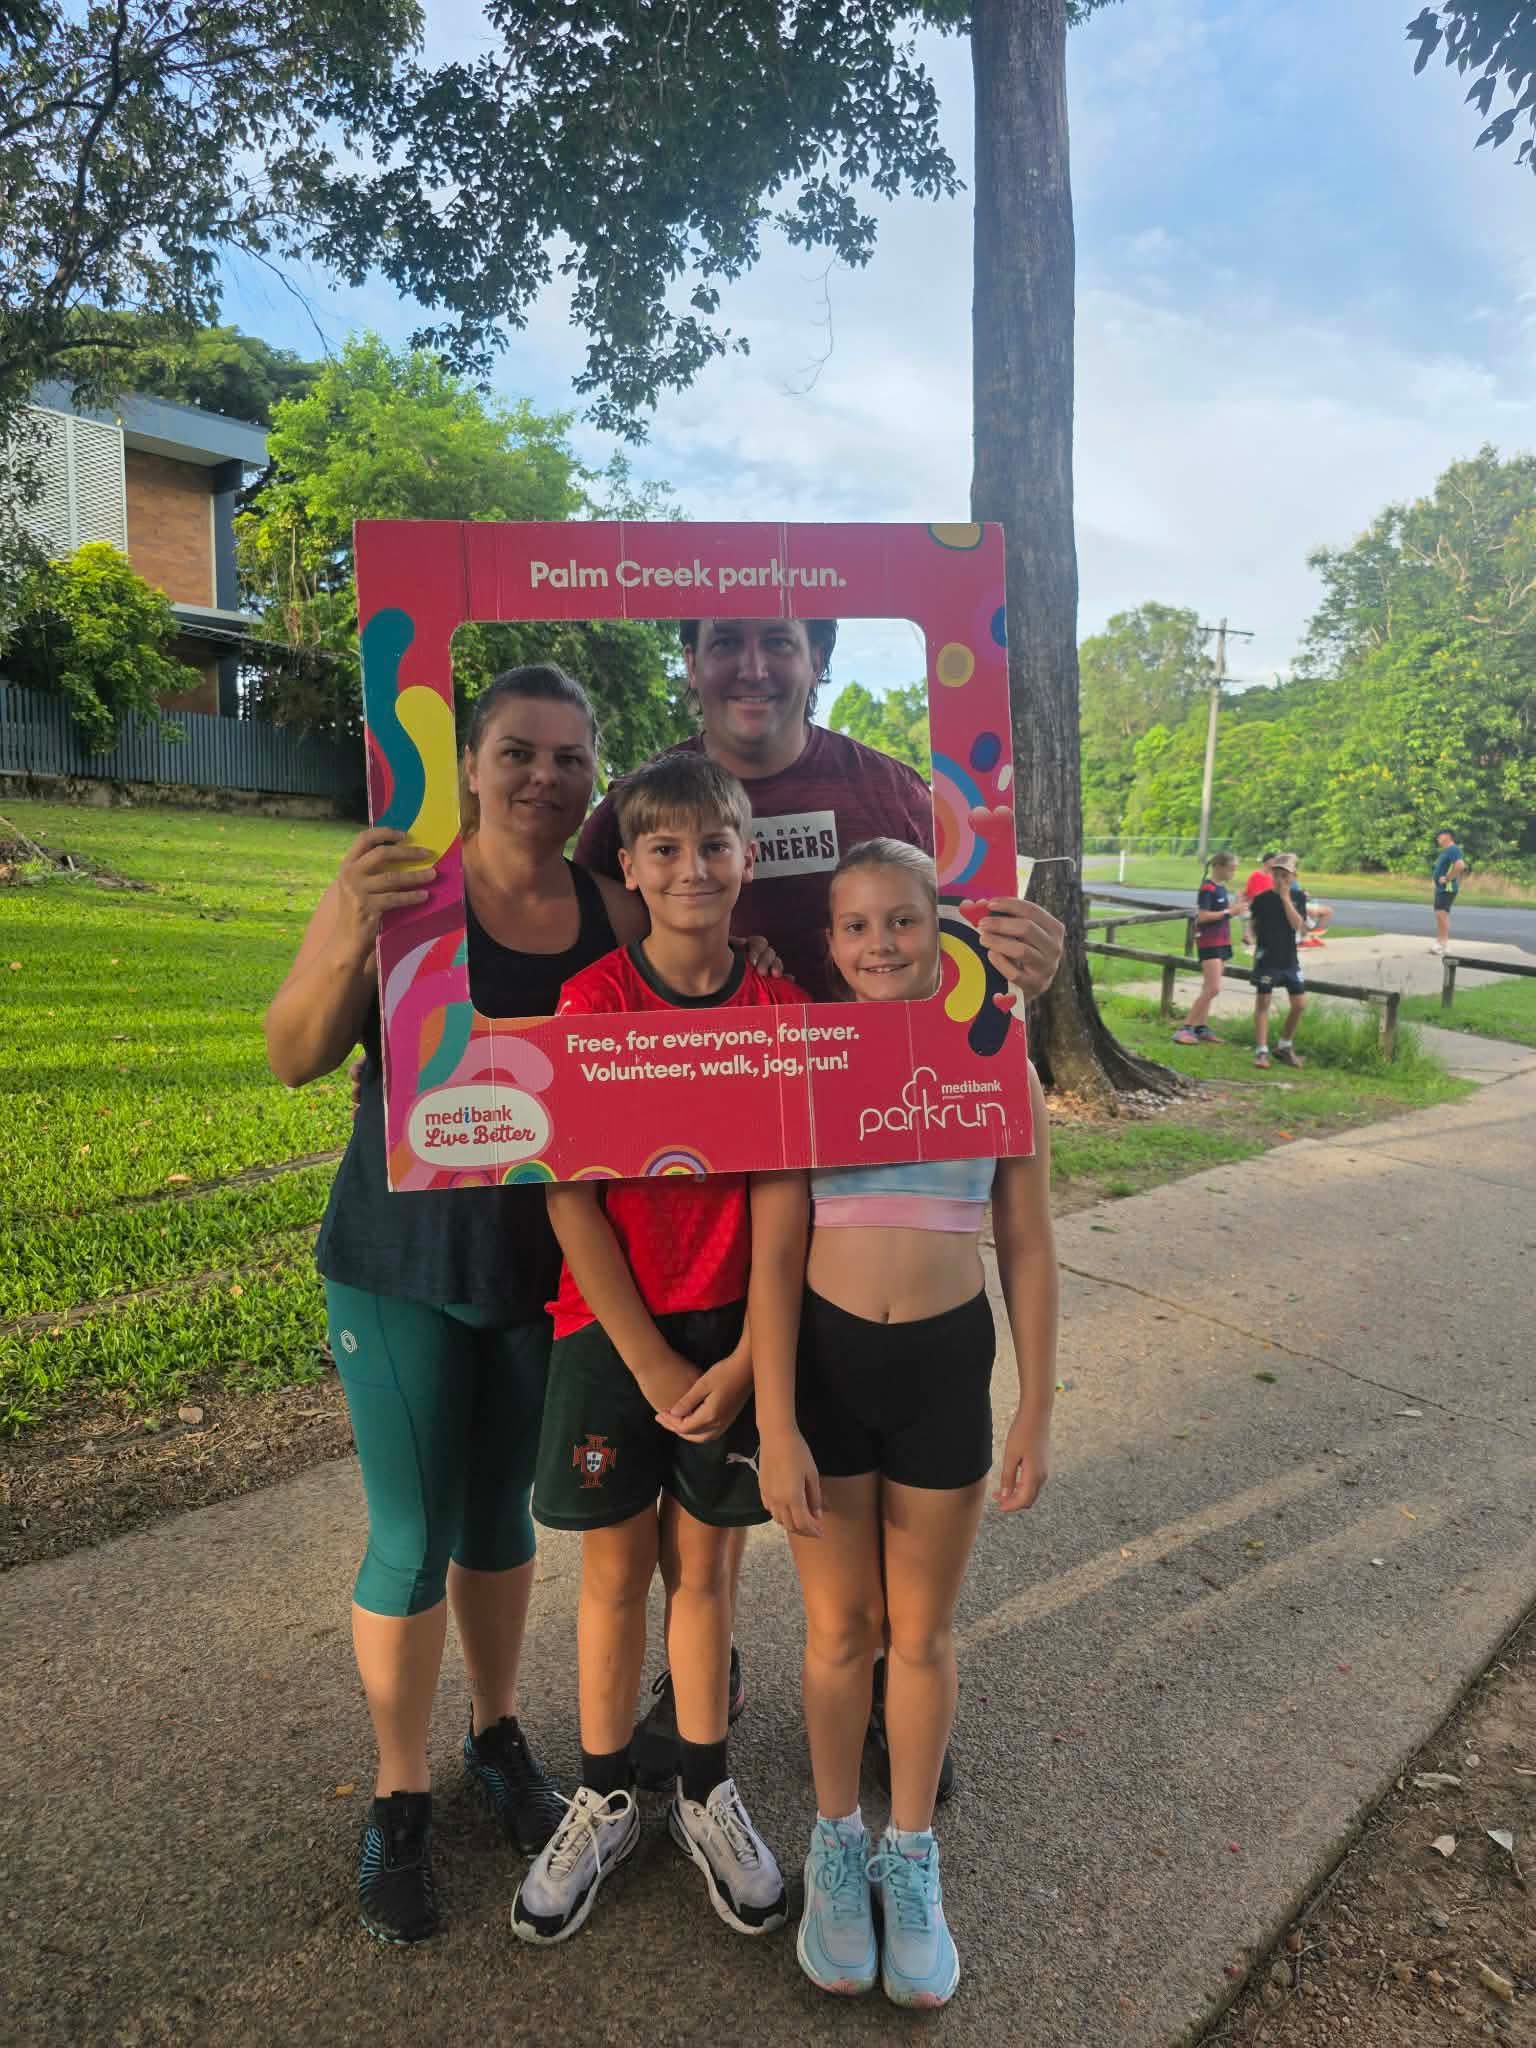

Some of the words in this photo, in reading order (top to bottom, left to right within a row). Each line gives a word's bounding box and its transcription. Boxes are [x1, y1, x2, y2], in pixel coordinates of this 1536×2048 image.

[529, 559, 608, 588] Palm
[615, 558, 713, 588] Creek
[718, 558, 847, 594] parkrun.
[755, 830, 835, 863] NEERS
[776, 825, 811, 837] BAY
[567, 1034, 622, 1055] Free,
[626, 1031, 659, 1050] for
[662, 1027, 773, 1051] everyone,
[777, 1023, 860, 1043] forever.
[581, 1061, 697, 1082] Volunteer,
[700, 1054, 759, 1078] walk,
[762, 1053, 804, 1079] jog,
[806, 1051, 849, 1072] run!
[941, 1079, 1003, 1095] medibank
[424, 1104, 513, 1126] medibank
[859, 1080, 1007, 1142] parkrun
[424, 1127, 470, 1148] Live
[472, 1124, 537, 1145] Better
